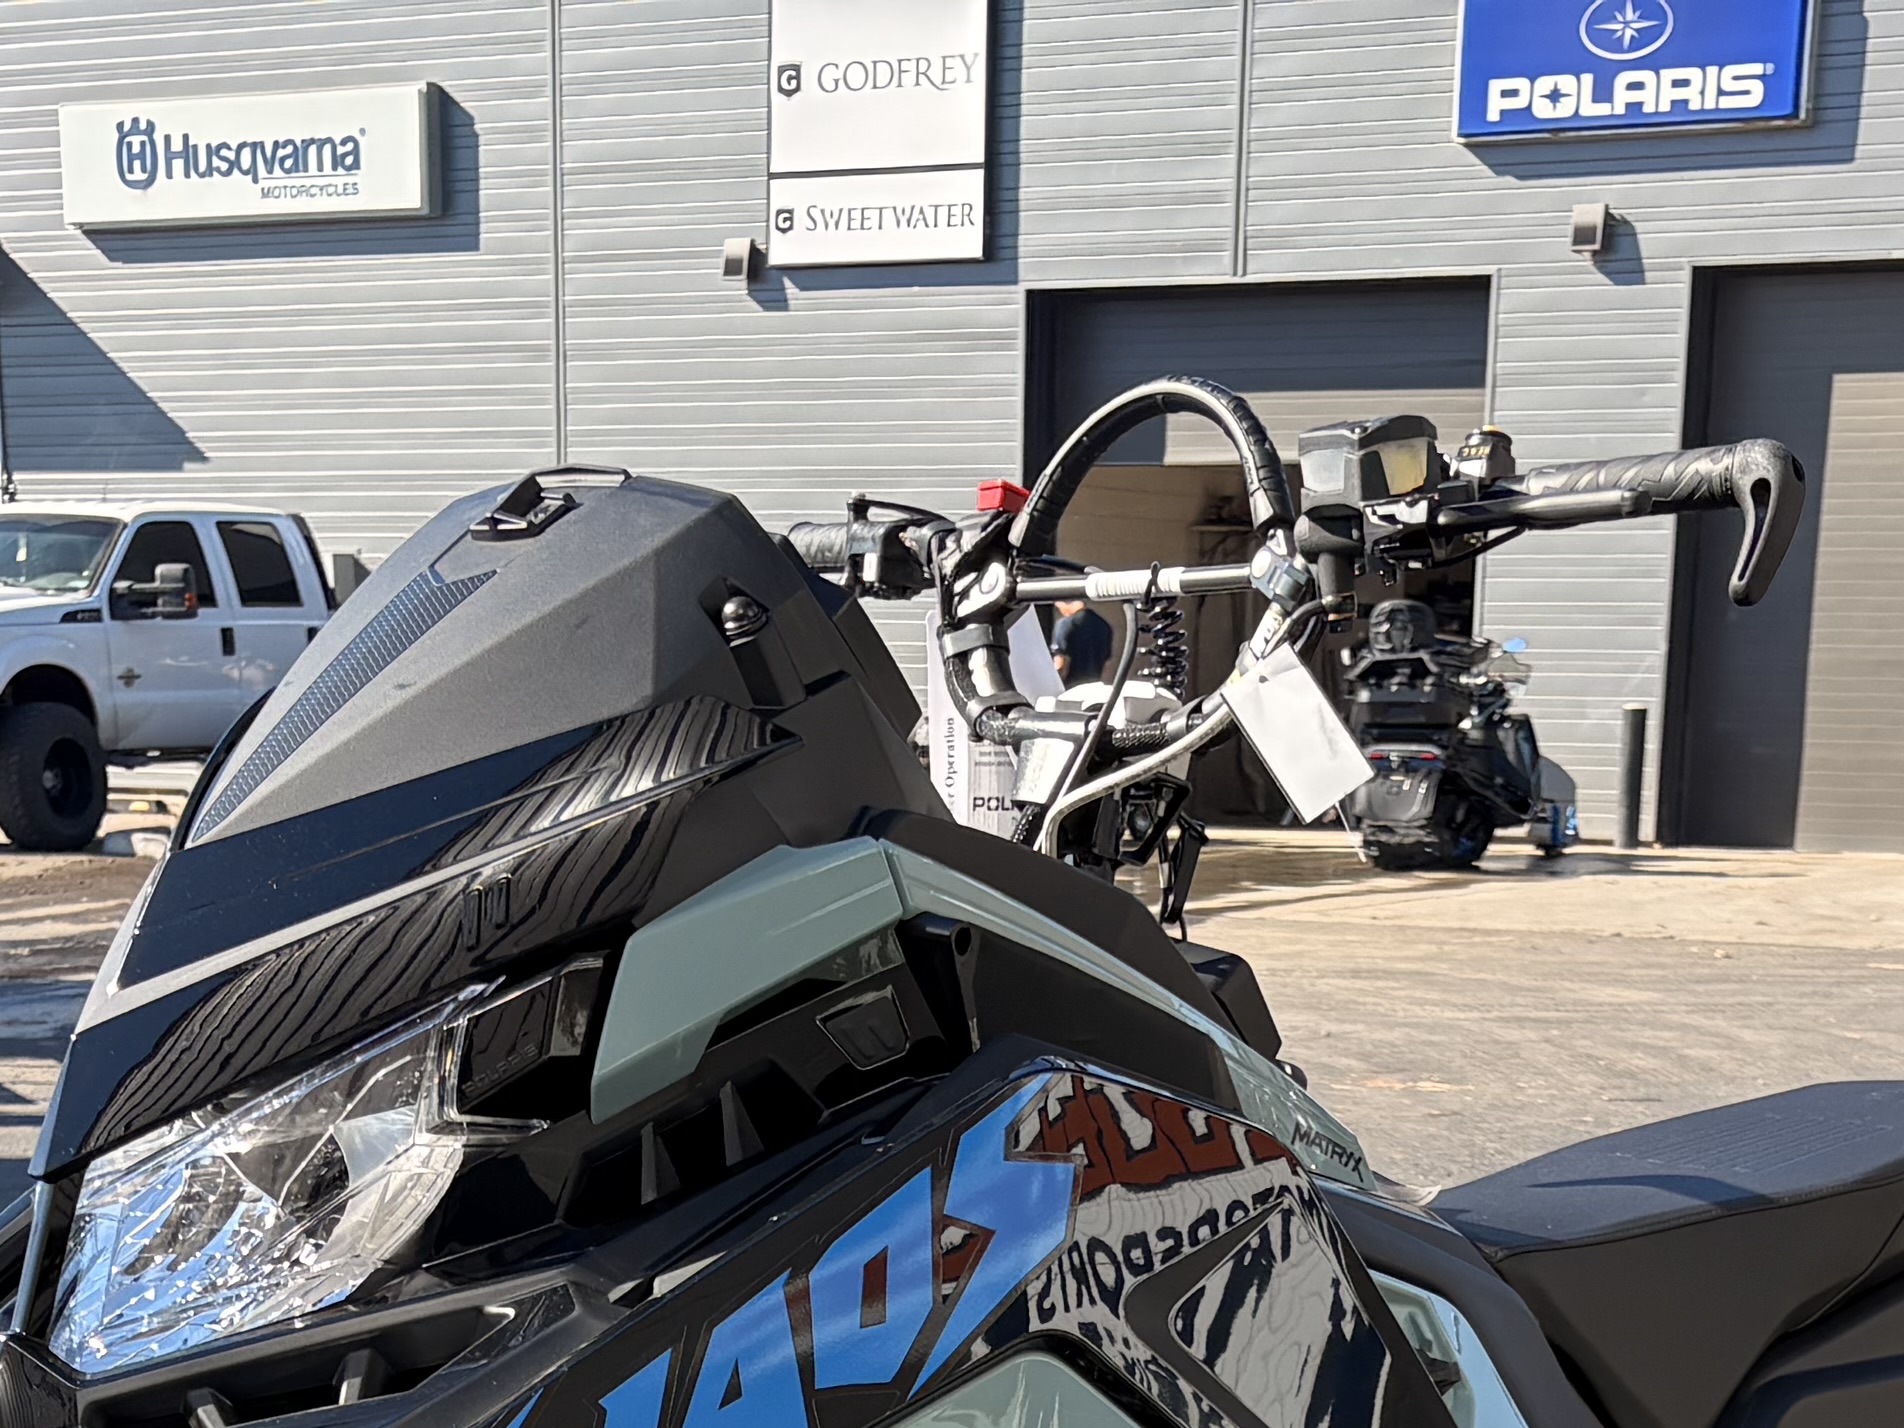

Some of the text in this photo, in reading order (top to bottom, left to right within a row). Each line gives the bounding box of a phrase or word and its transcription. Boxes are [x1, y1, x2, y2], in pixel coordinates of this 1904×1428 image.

[817, 53, 979, 93] GODFREY
[1486, 62, 1765, 122] POLARIS
[163, 132, 362, 184] Husqvarna
[260, 182, 360, 200] MOTORCYCLES
[805, 202, 975, 232] SWEETWATER
[944, 717, 958, 788] Operation
[1291, 1121, 1364, 1183] MATRYX
